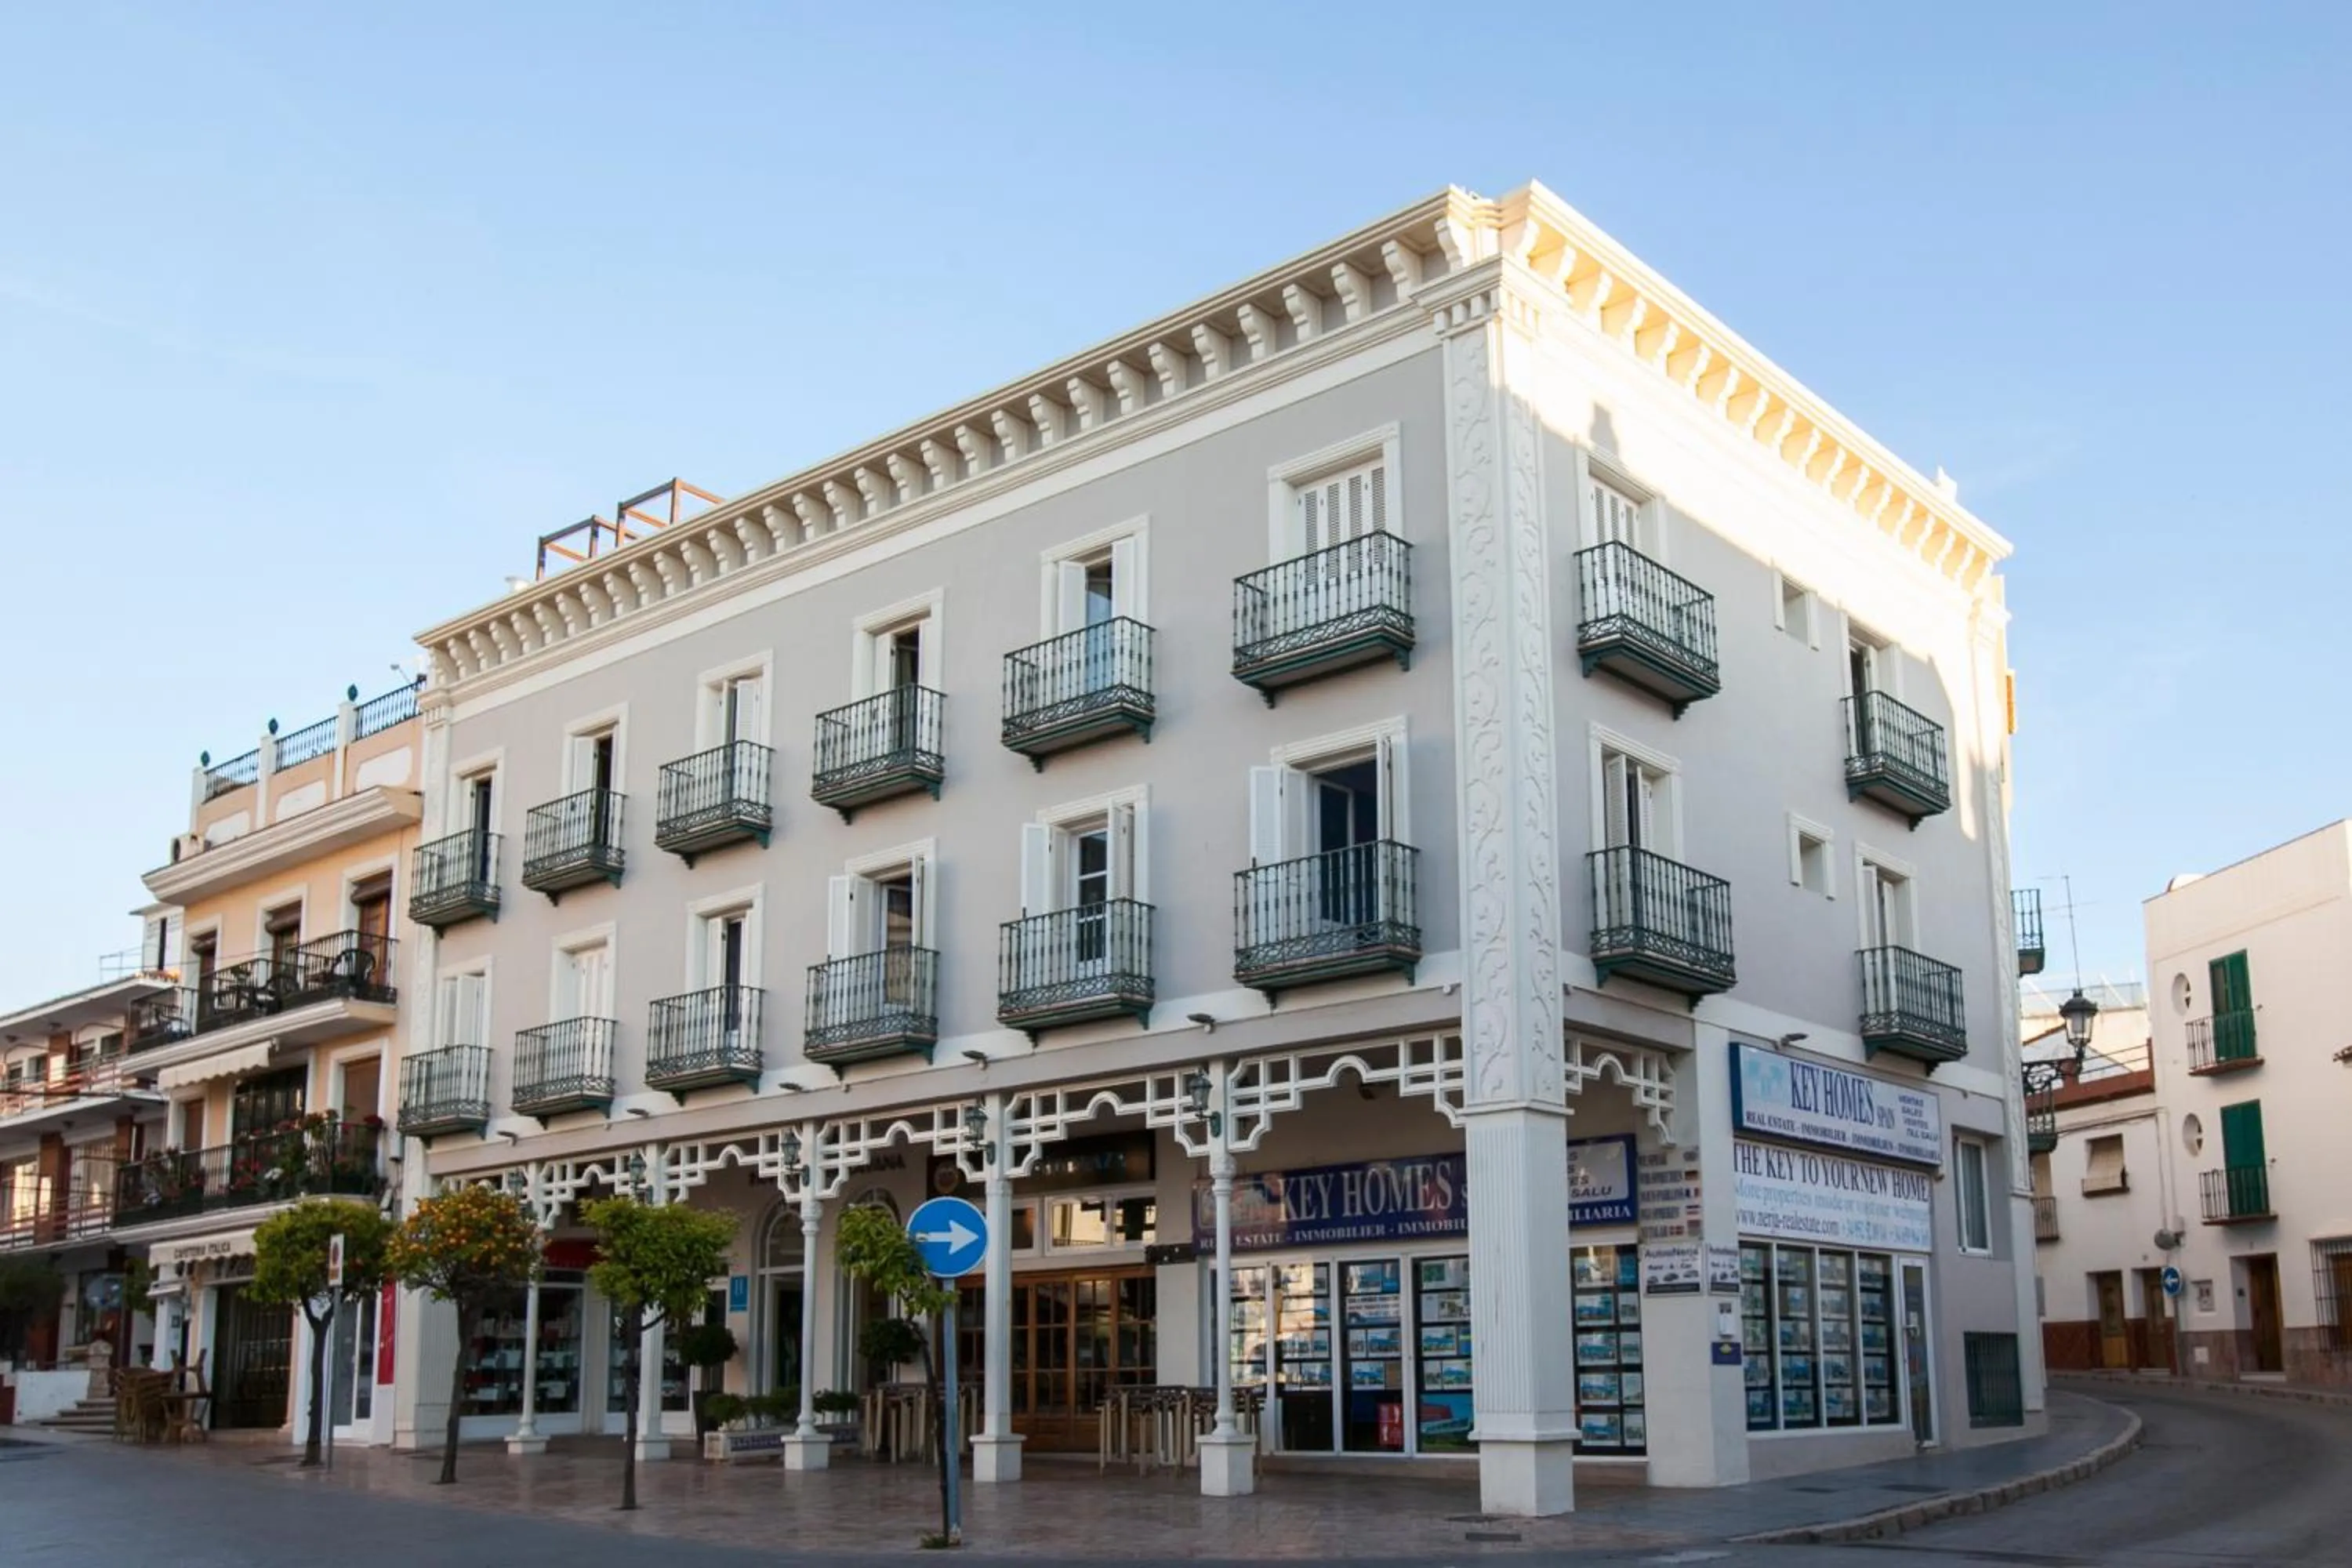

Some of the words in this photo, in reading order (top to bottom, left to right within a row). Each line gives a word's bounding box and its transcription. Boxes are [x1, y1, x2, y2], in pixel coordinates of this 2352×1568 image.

[1790, 1061, 1820, 1113] KEY
[1823, 1069, 1875, 1127] HOMES
[1746, 1110, 1766, 1126] REAL
[1767, 1116, 1795, 1132] ESTATE
[1278, 1174, 1334, 1221] KEY
[1341, 1160, 1454, 1216] HOMES
[1571, 1185, 1612, 1198] SALU
[1733, 1142, 1762, 1176] THE
[1765, 1148, 1794, 1181] KEY
[1799, 1154, 1819, 1185] TO
[1892, 1170, 1929, 1203] HOME
[1295, 1224, 1385, 1242] IMMOBILIER
